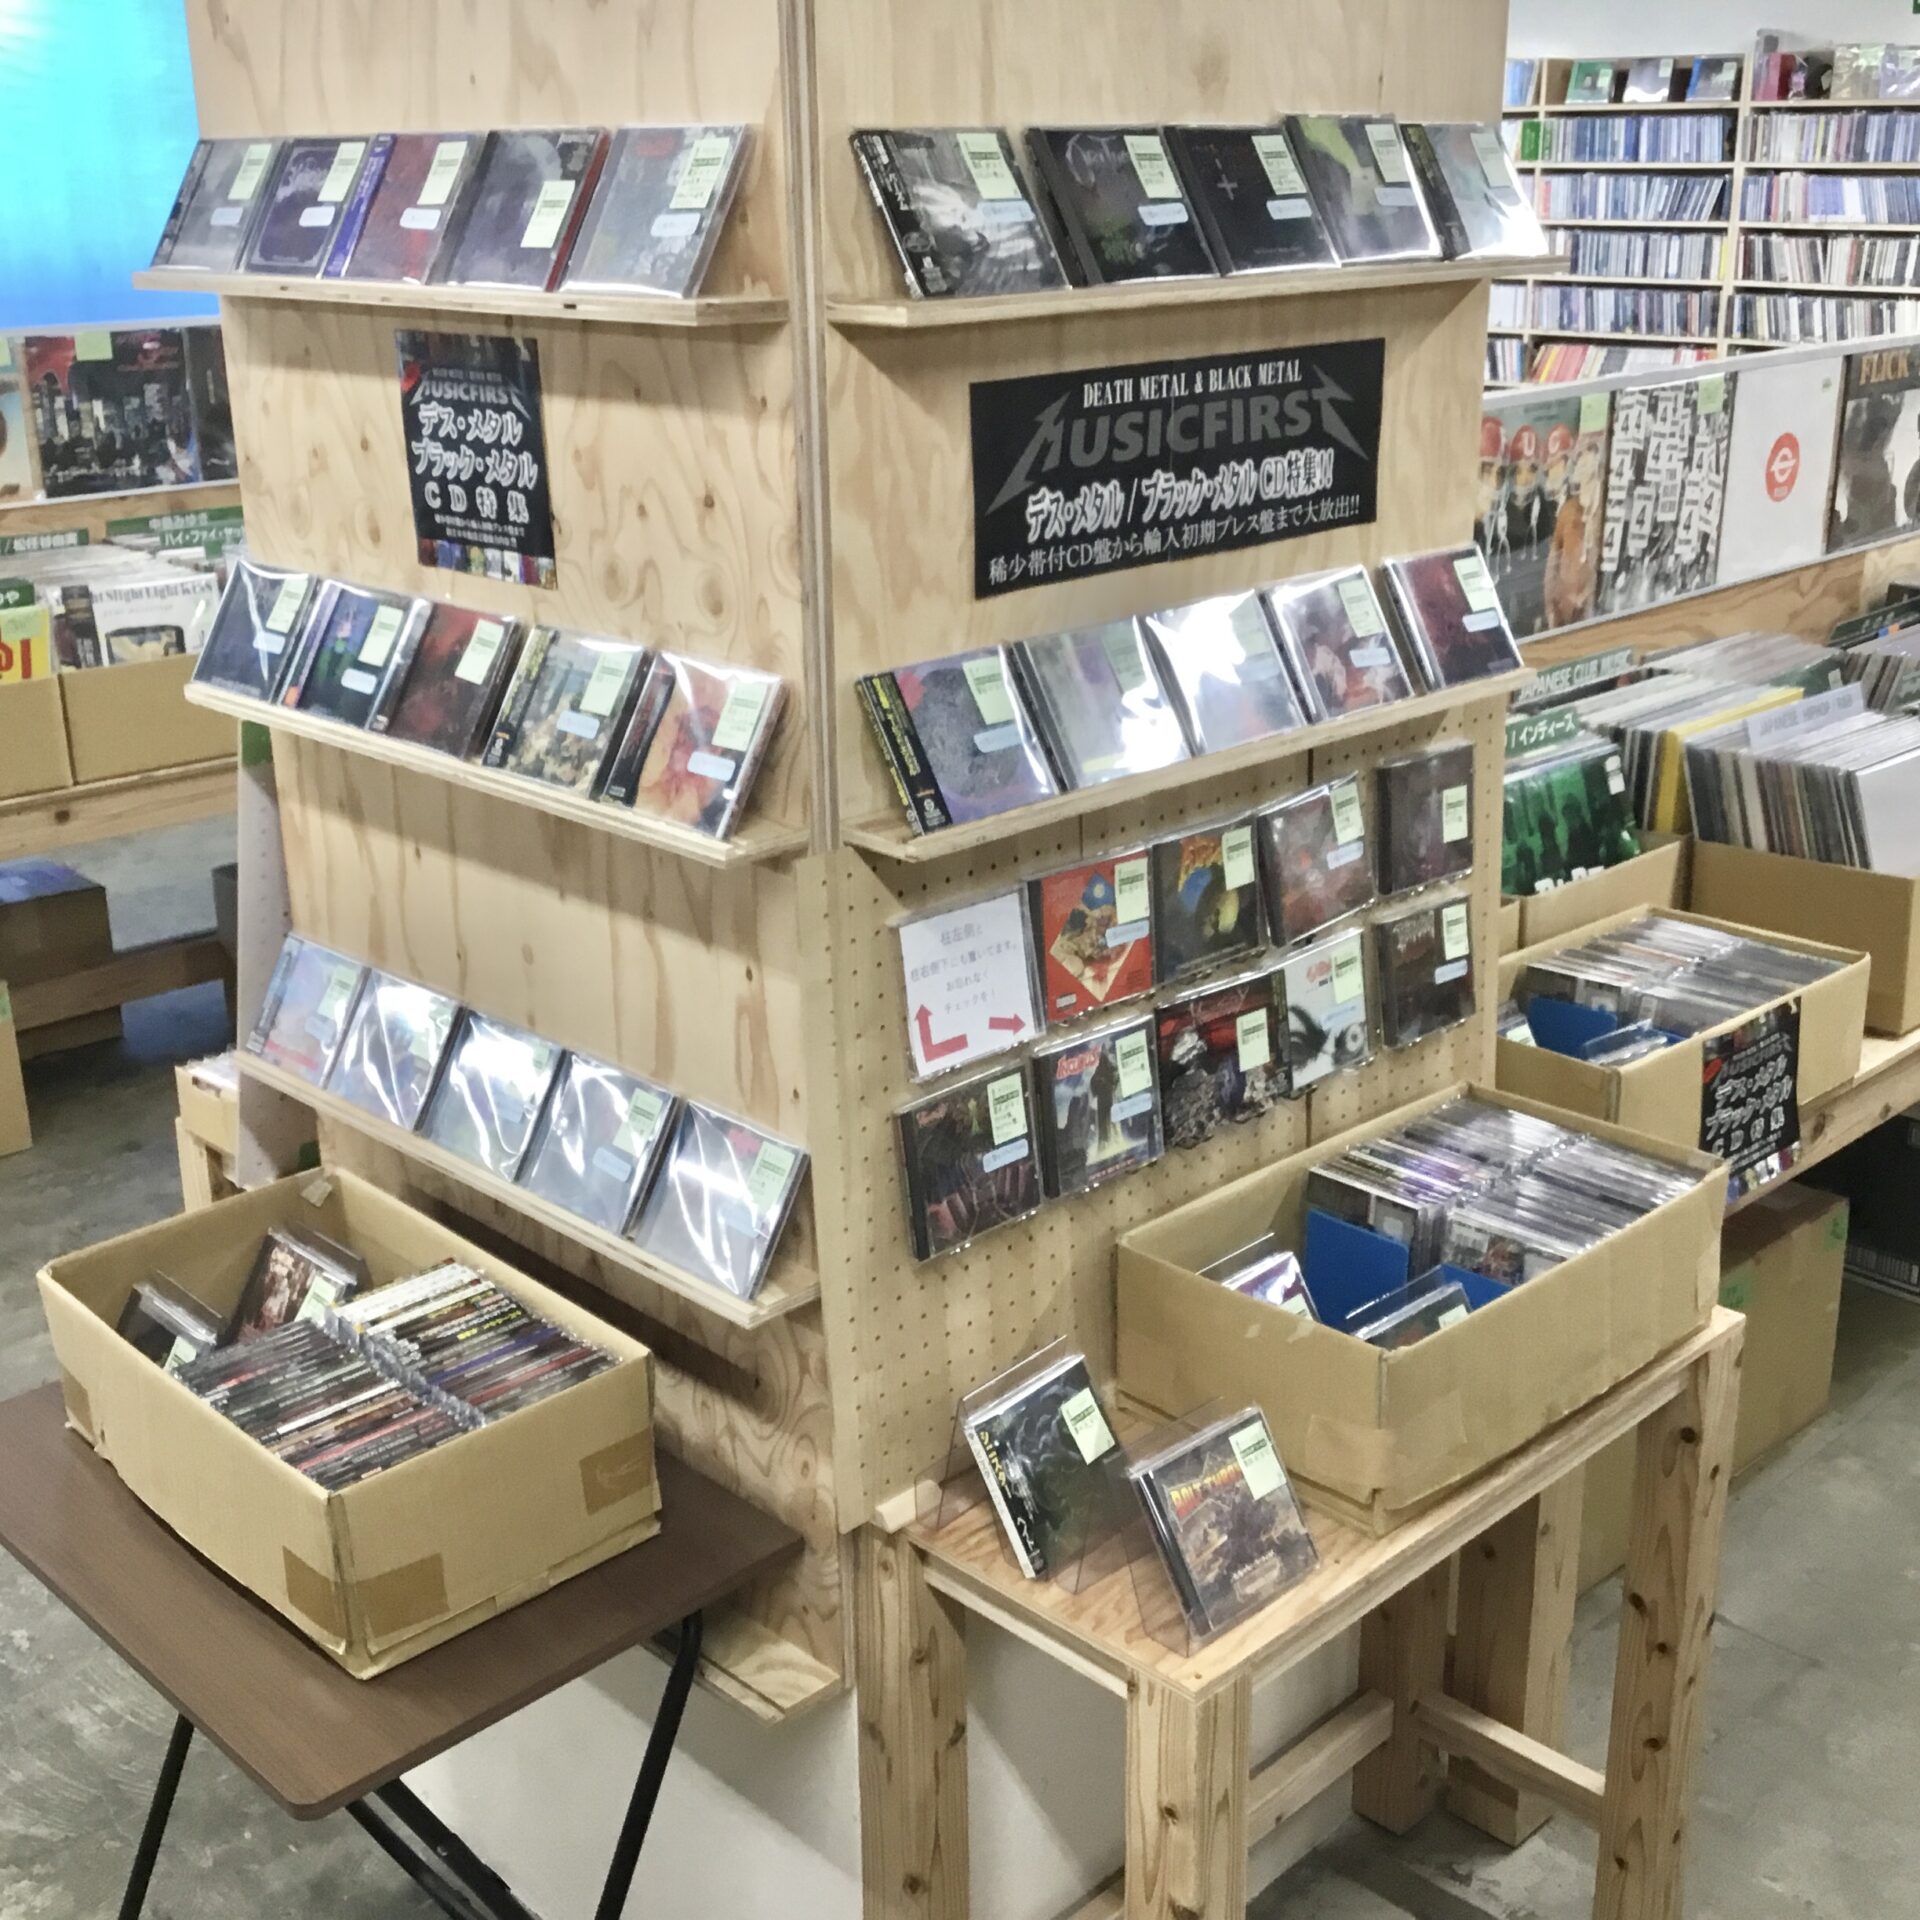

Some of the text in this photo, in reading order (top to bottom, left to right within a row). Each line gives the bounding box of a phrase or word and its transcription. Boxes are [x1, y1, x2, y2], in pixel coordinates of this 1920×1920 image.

[1084, 359, 1302, 409] DEATH METAL & BLACK METAL
[1860, 349, 1910, 386] FLICK
[418, 401, 523, 446] デス・メタル
[985, 364, 1368, 516] MUSICFIRST
[411, 437, 538, 490] ブラック・メタル
[1026, 480, 1125, 543] デス・メタル
[1141, 459, 1259, 523] ブラック・メタル
[1519, 667, 1572, 699] JAPANESE
[1573, 660, 1599, 685] CLUB
